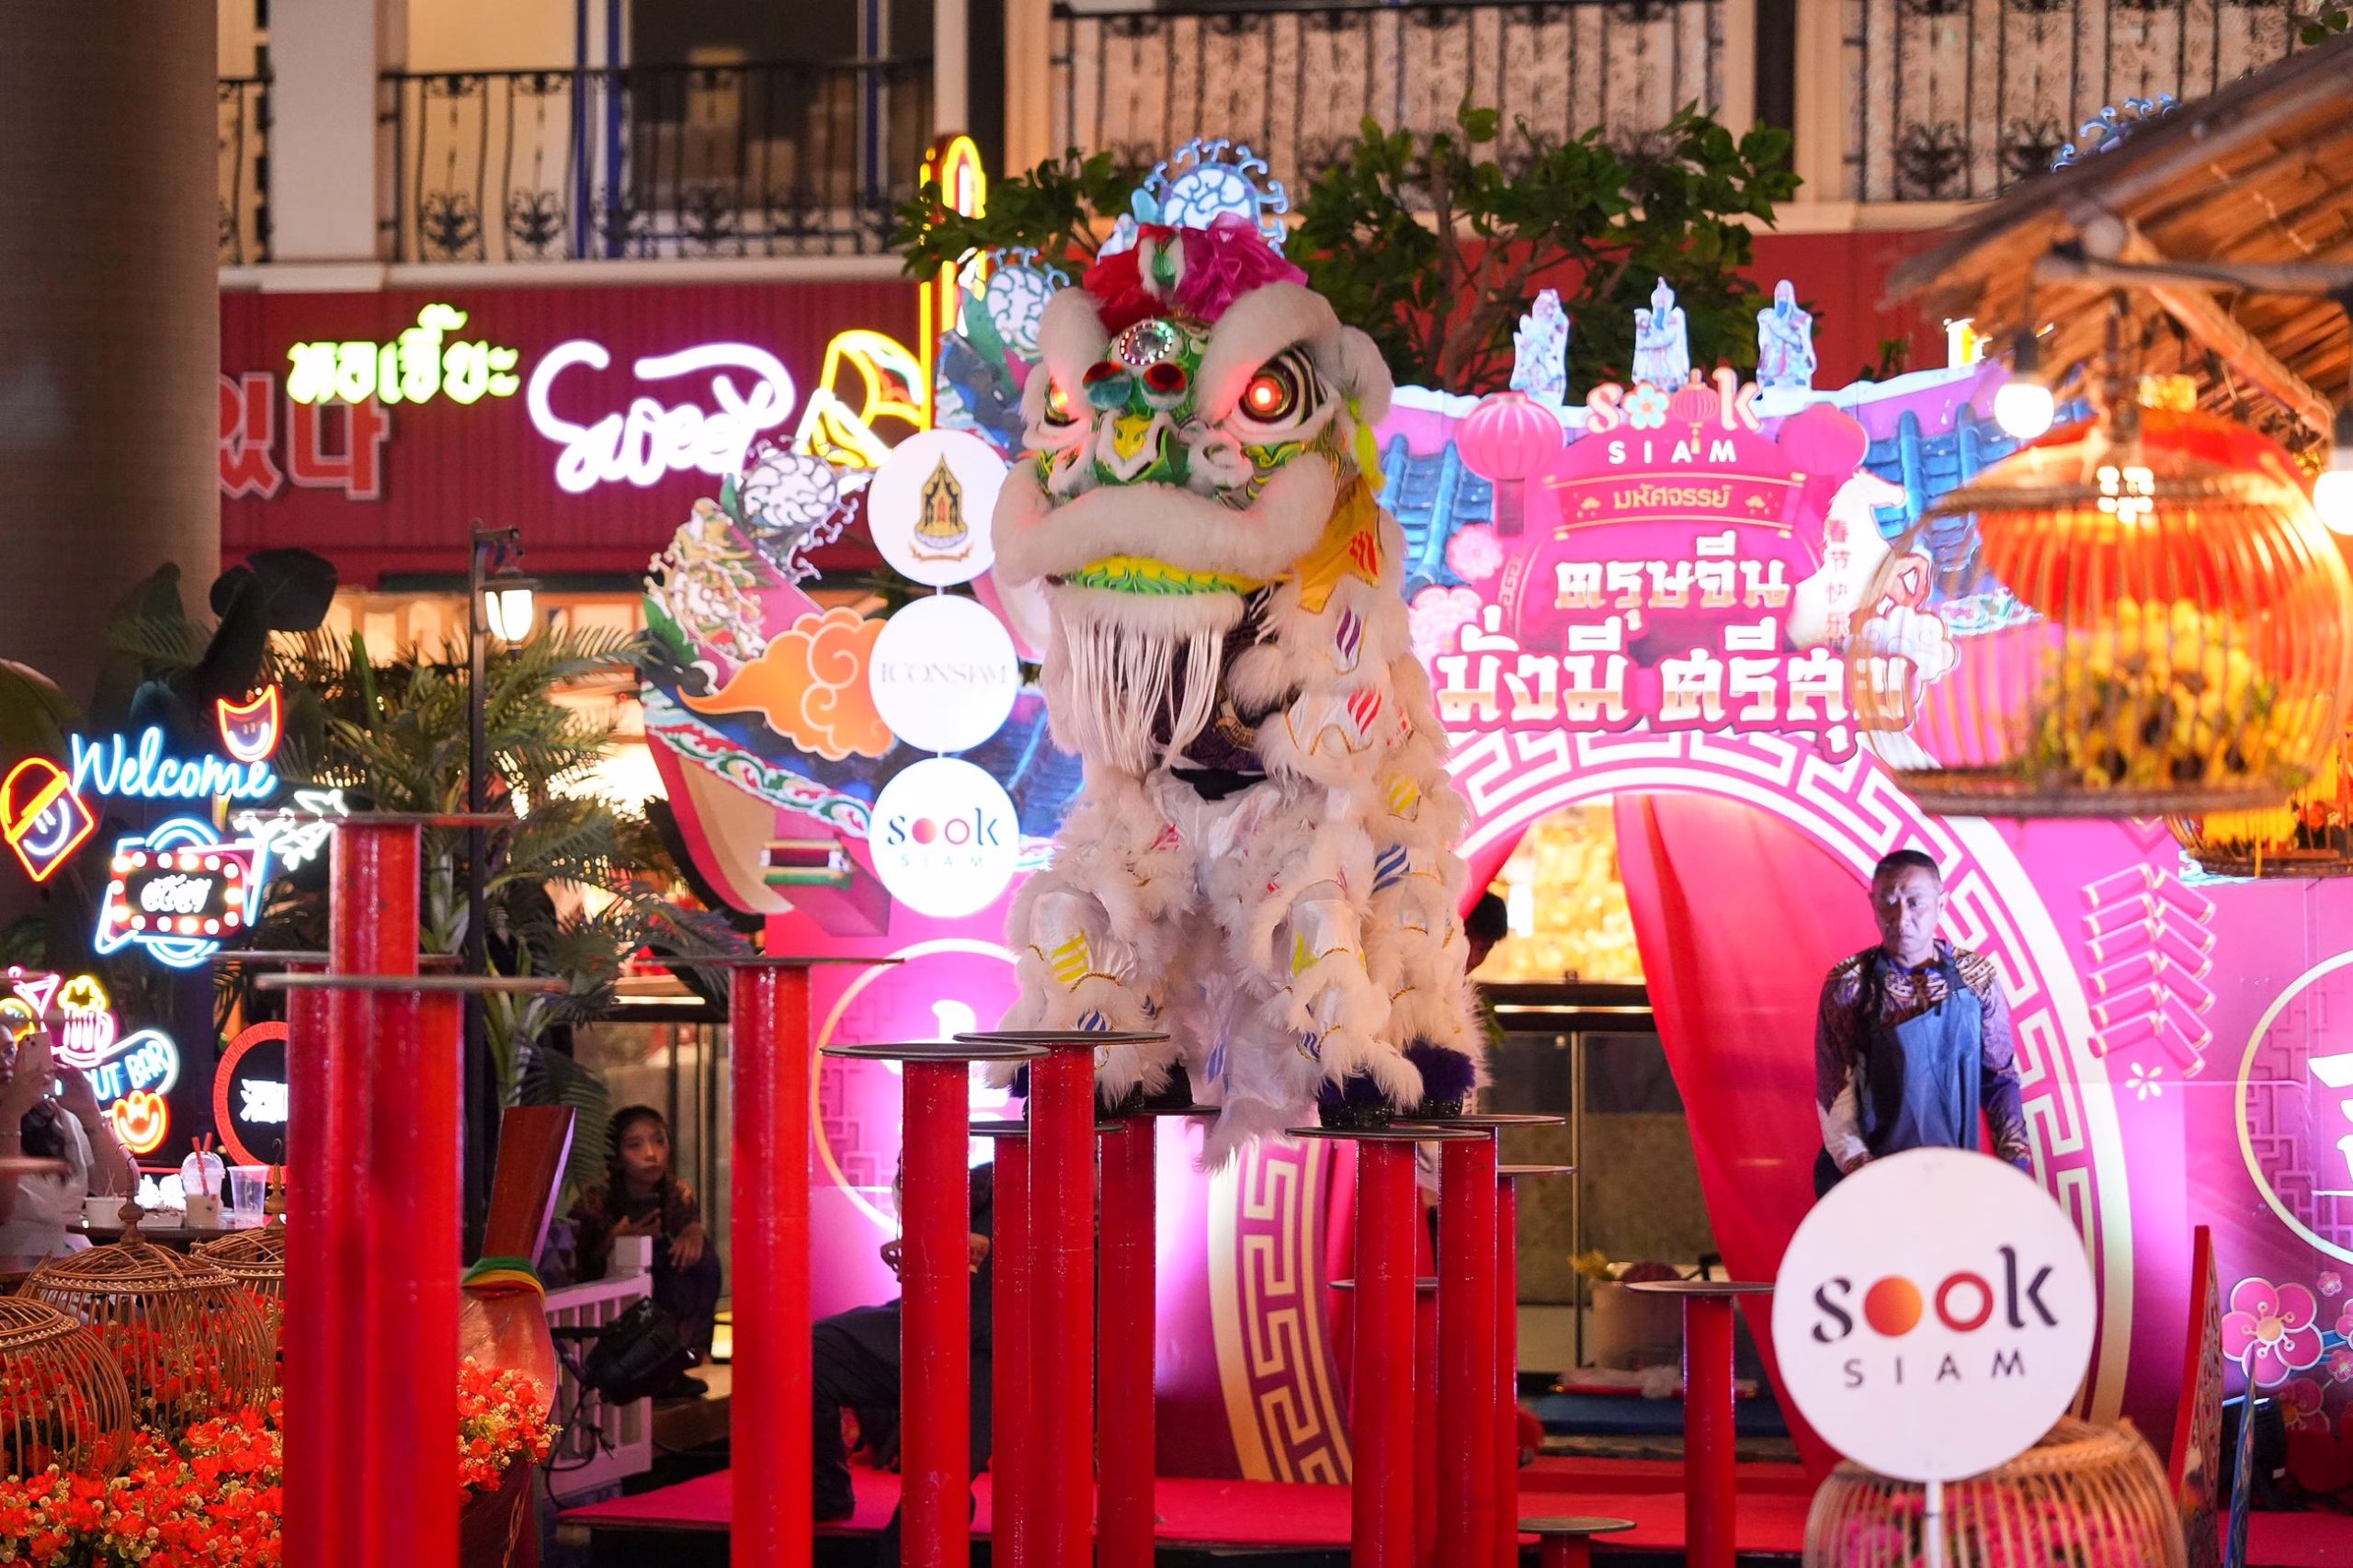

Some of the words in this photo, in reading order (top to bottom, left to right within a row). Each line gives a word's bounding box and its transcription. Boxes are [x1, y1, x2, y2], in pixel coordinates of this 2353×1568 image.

[527, 338, 797, 493] Sweet
[1608, 439, 1737, 464] SIAM
[1613, 483, 1733, 510] มหัศจรรย์
[1554, 530, 1790, 630] ตรุษจีน
[1825, 519, 1851, 639] 春节快乐
[881, 662, 1008, 685] ICONSIAM
[1436, 604, 1631, 722] มั่งมี
[71, 726, 277, 798] Welcome
[887, 807, 999, 846] sook
[901, 854, 983, 868] SIAM
[124, 1040, 170, 1090] BAR
[1811, 1244, 2059, 1345] sook
[1842, 1347, 2026, 1389] SIAM
